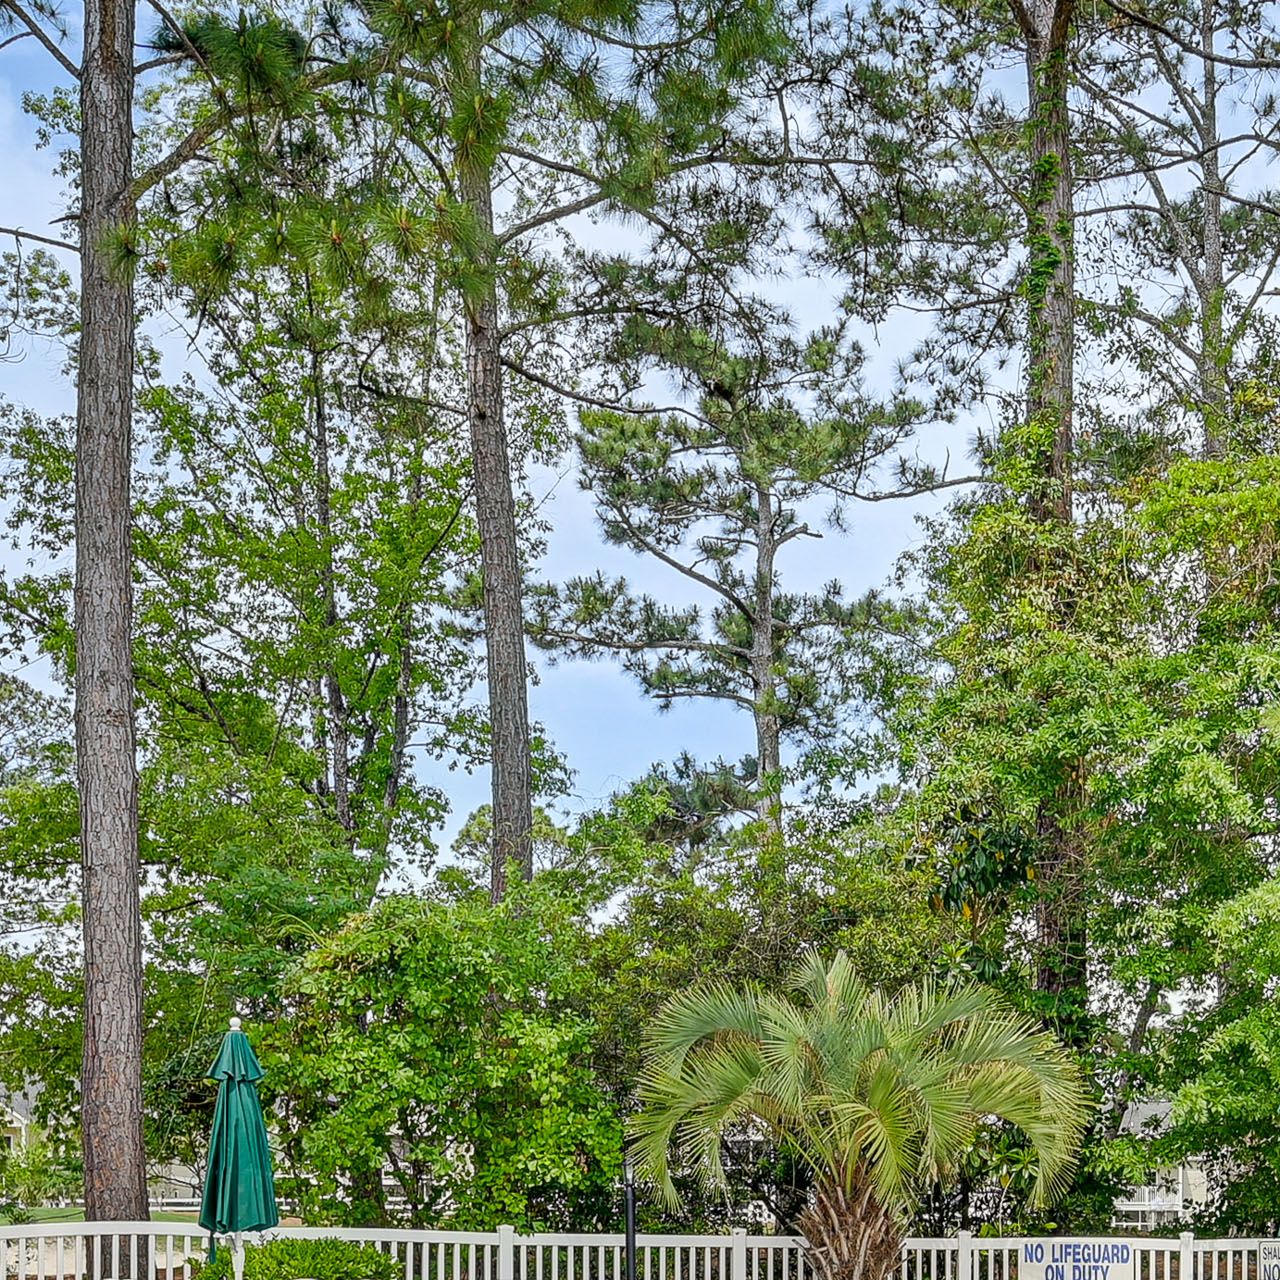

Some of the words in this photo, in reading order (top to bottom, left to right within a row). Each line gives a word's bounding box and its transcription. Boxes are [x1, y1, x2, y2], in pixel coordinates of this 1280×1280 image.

[1024, 1243, 1044, 1263] NO
[1051, 1243, 1130, 1264] LIFEGUARD
[1263, 1263, 1280, 1280] NO
